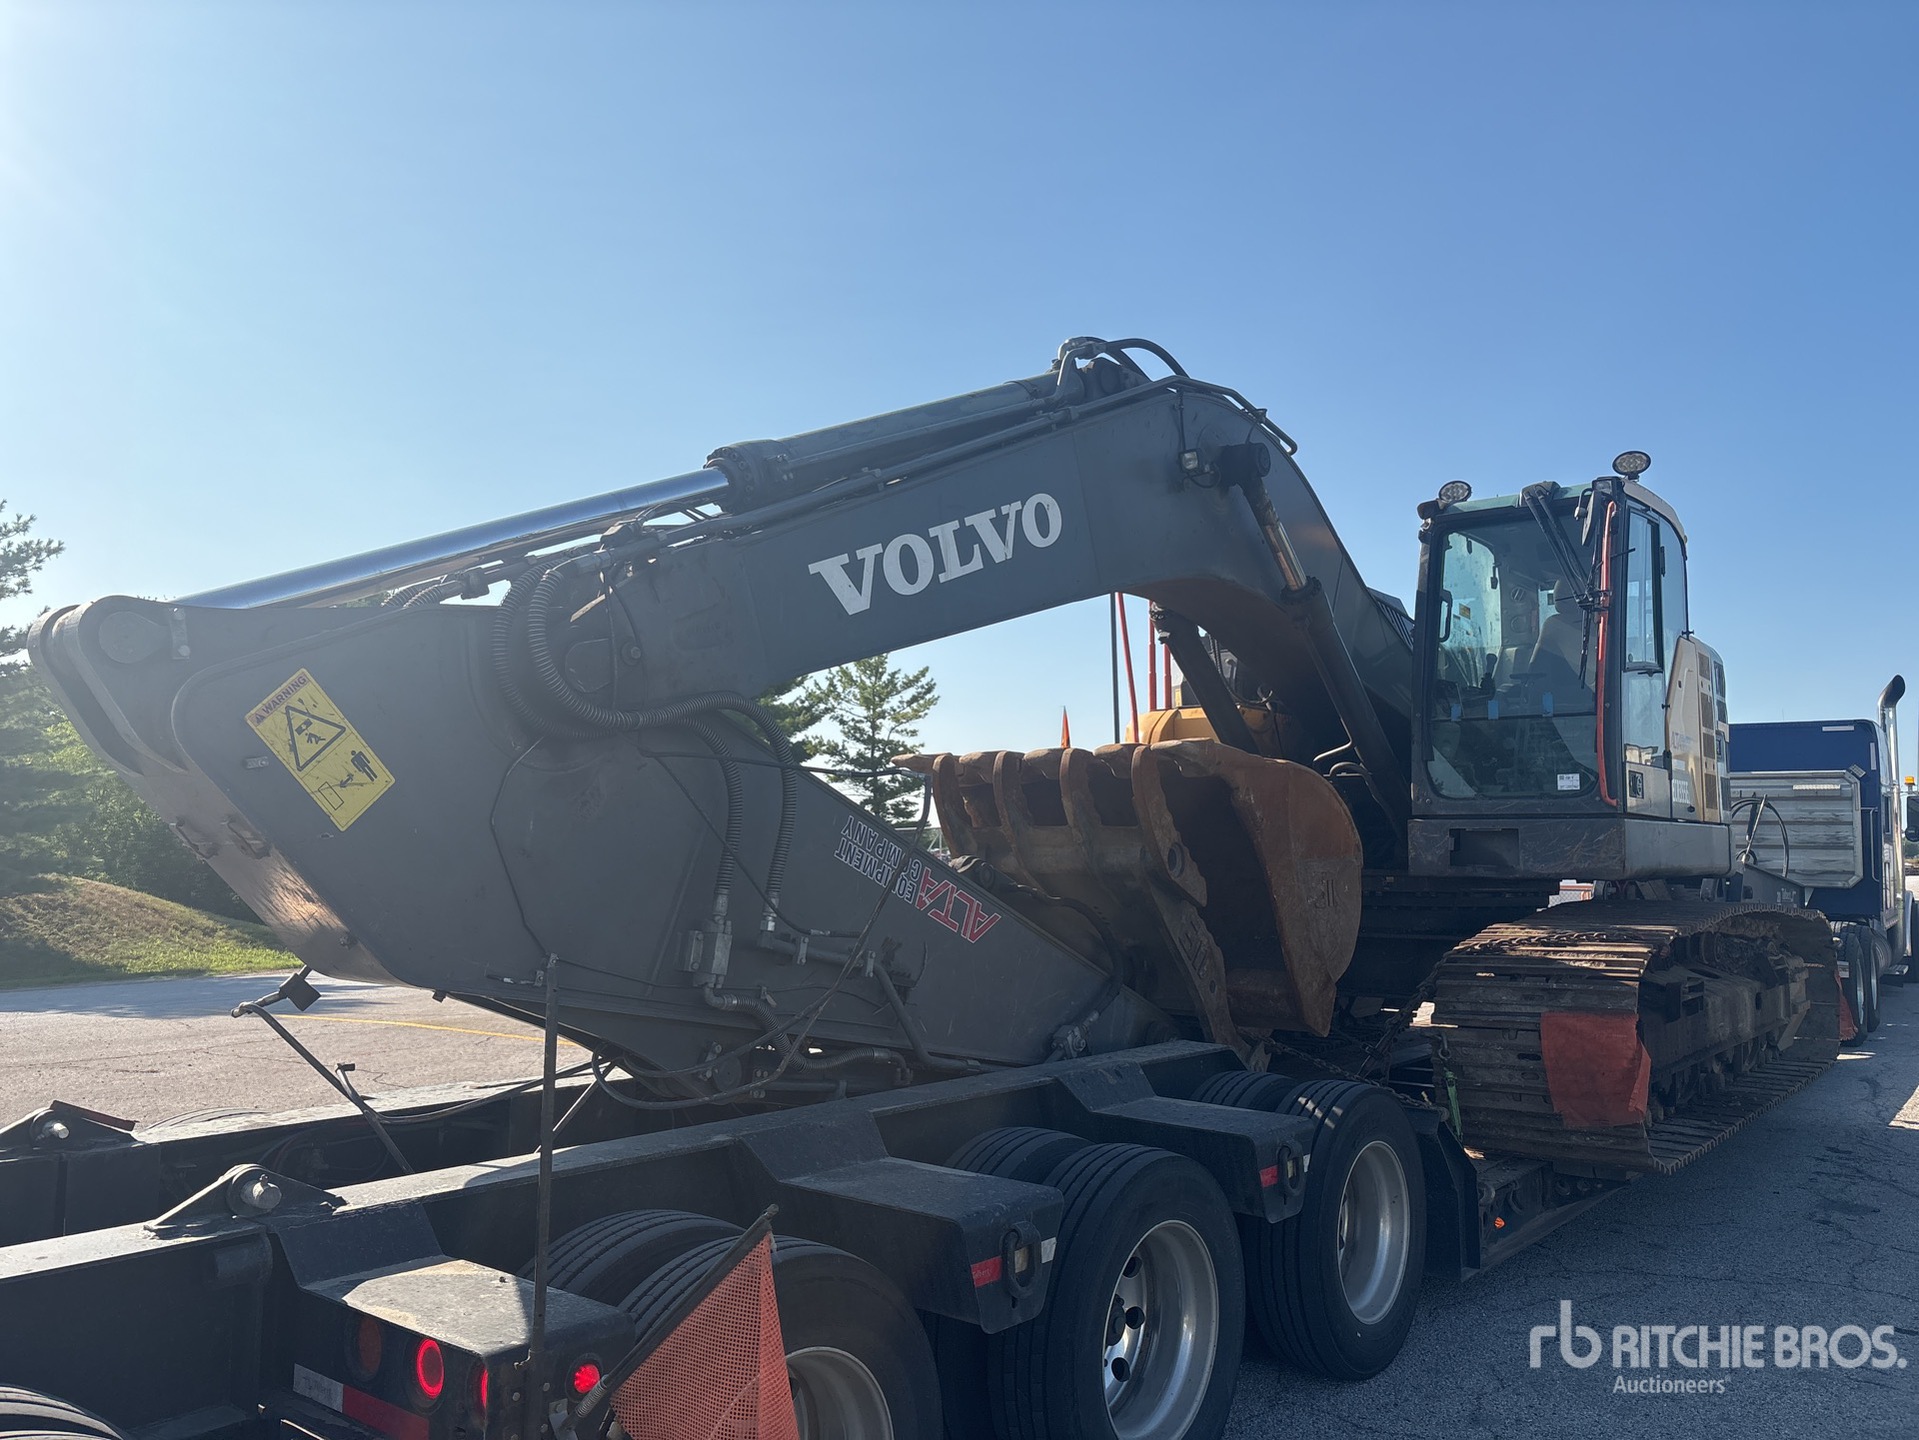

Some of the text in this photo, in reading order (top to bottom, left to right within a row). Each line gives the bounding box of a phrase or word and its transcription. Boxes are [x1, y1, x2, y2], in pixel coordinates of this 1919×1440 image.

[808, 493, 1062, 615] VOLVO
[262, 675, 307, 715] WARNING
[834, 838, 916, 904] EQIPMENT
[915, 867, 1002, 943] ALTA
